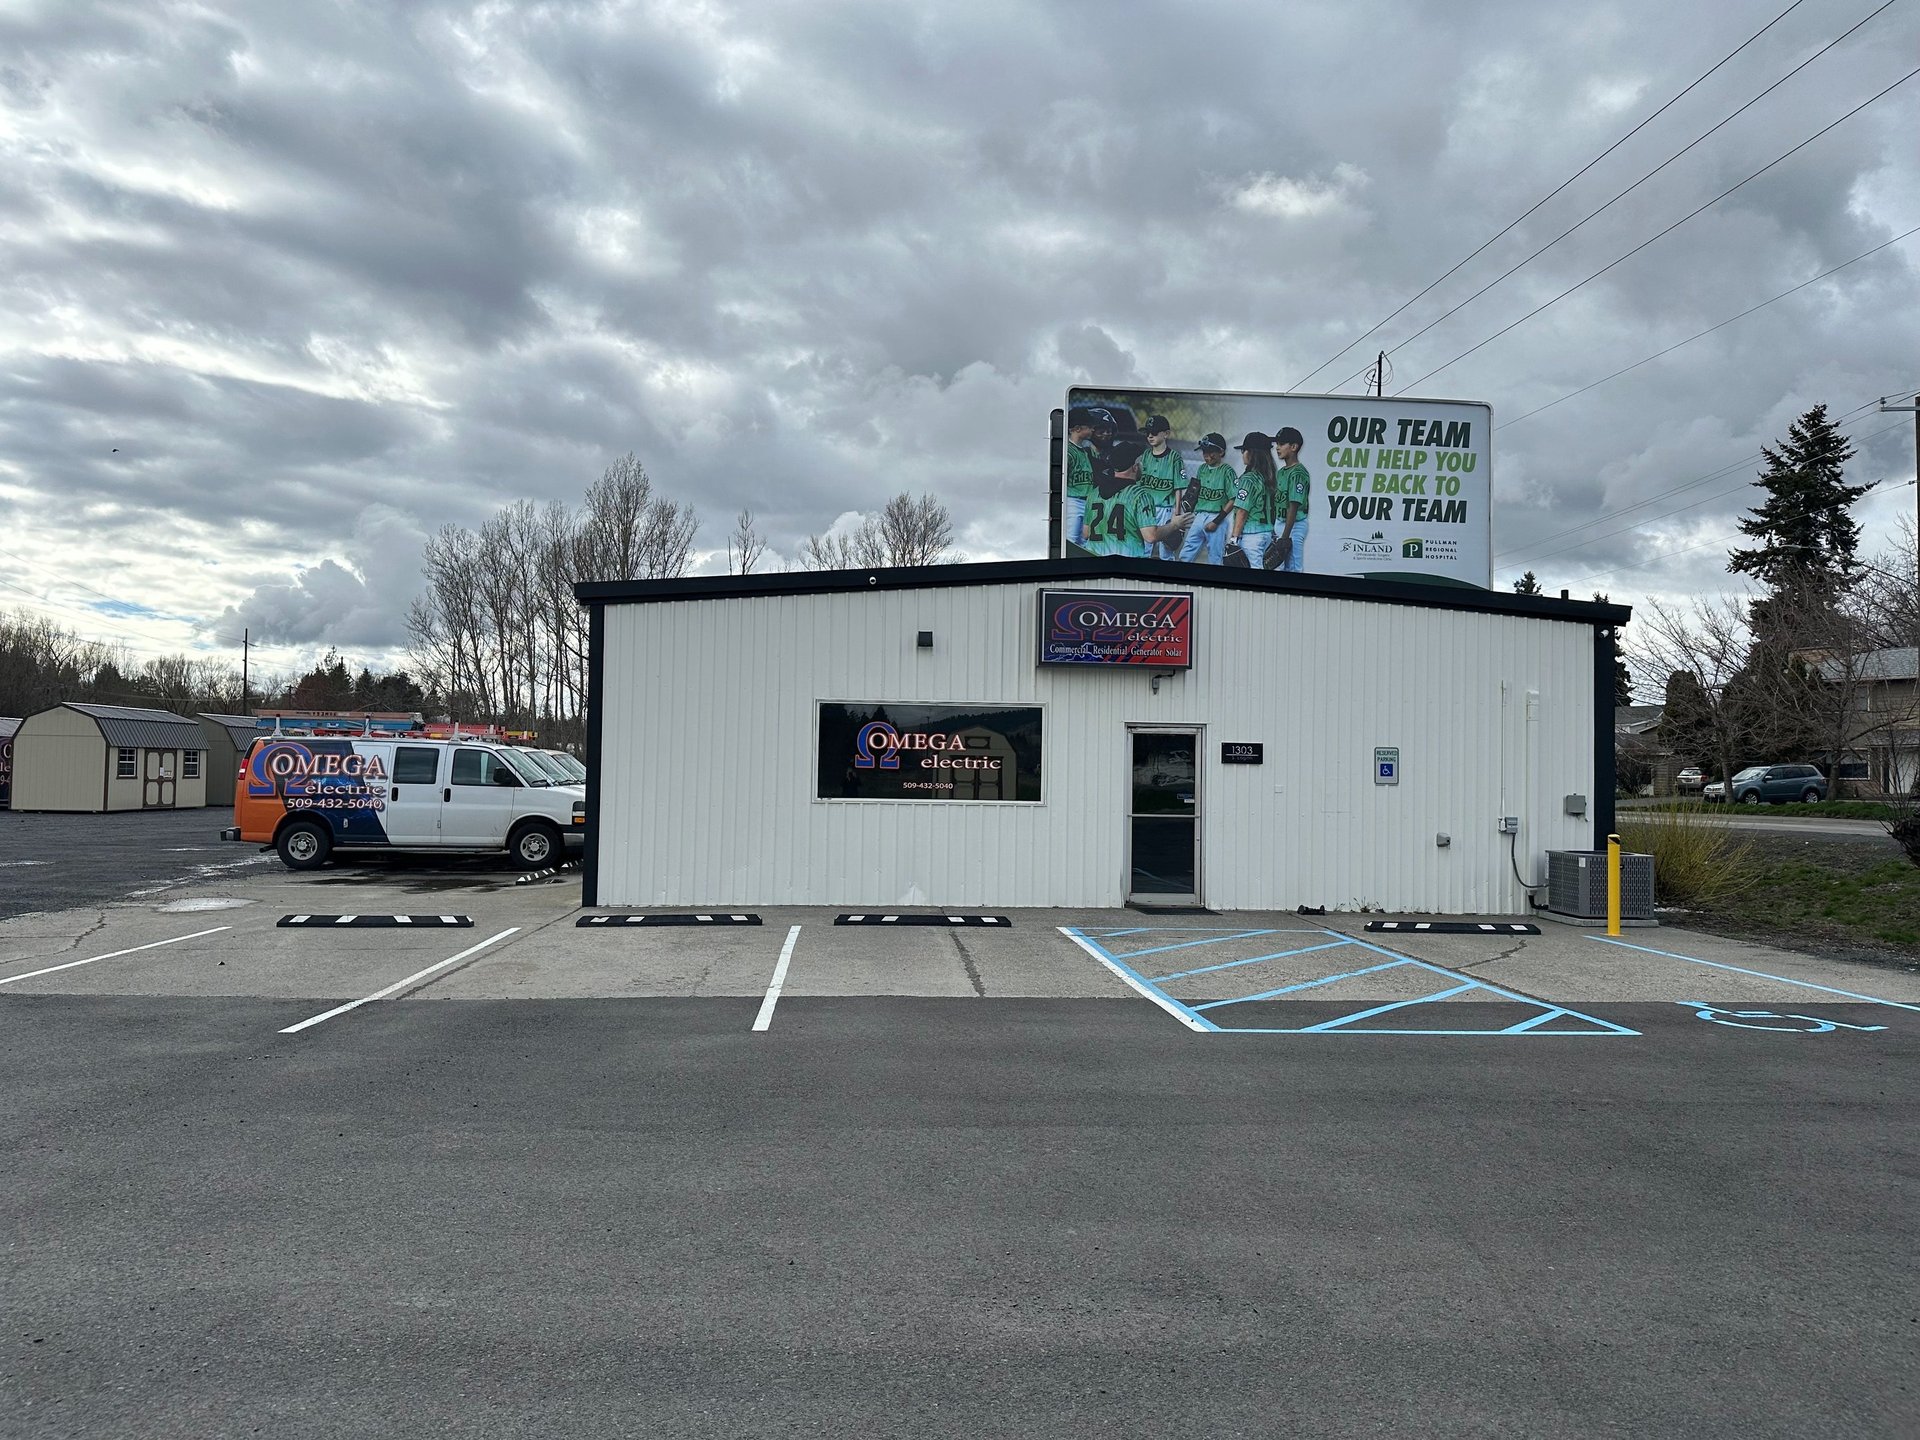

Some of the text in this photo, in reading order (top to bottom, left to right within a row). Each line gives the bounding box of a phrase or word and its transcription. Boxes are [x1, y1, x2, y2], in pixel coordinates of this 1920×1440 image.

[1327, 415, 1471, 448] OUR TEAM
[1326, 447, 1477, 473] CAN HELP YOU
[1326, 471, 1460, 496] GET BACK TO
[1327, 495, 1467, 523] YOUR TEAM
[1089, 503, 1126, 541] 24
[1353, 544, 1393, 553] INLAND
[1079, 611, 1176, 629] OMEGA
[1127, 632, 1183, 643] electric
[1049, 643, 1182, 657] Commercial Residential Generator Solar
[869, 732, 966, 751] OMEGA
[1231, 745, 1253, 755] 1303
[271, 753, 385, 776] OMEGA
[921, 754, 1001, 769] electric
[304, 782, 384, 795] electric
[903, 782, 953, 790] 509-432-5040
[286, 798, 383, 809] 509-432-5040
